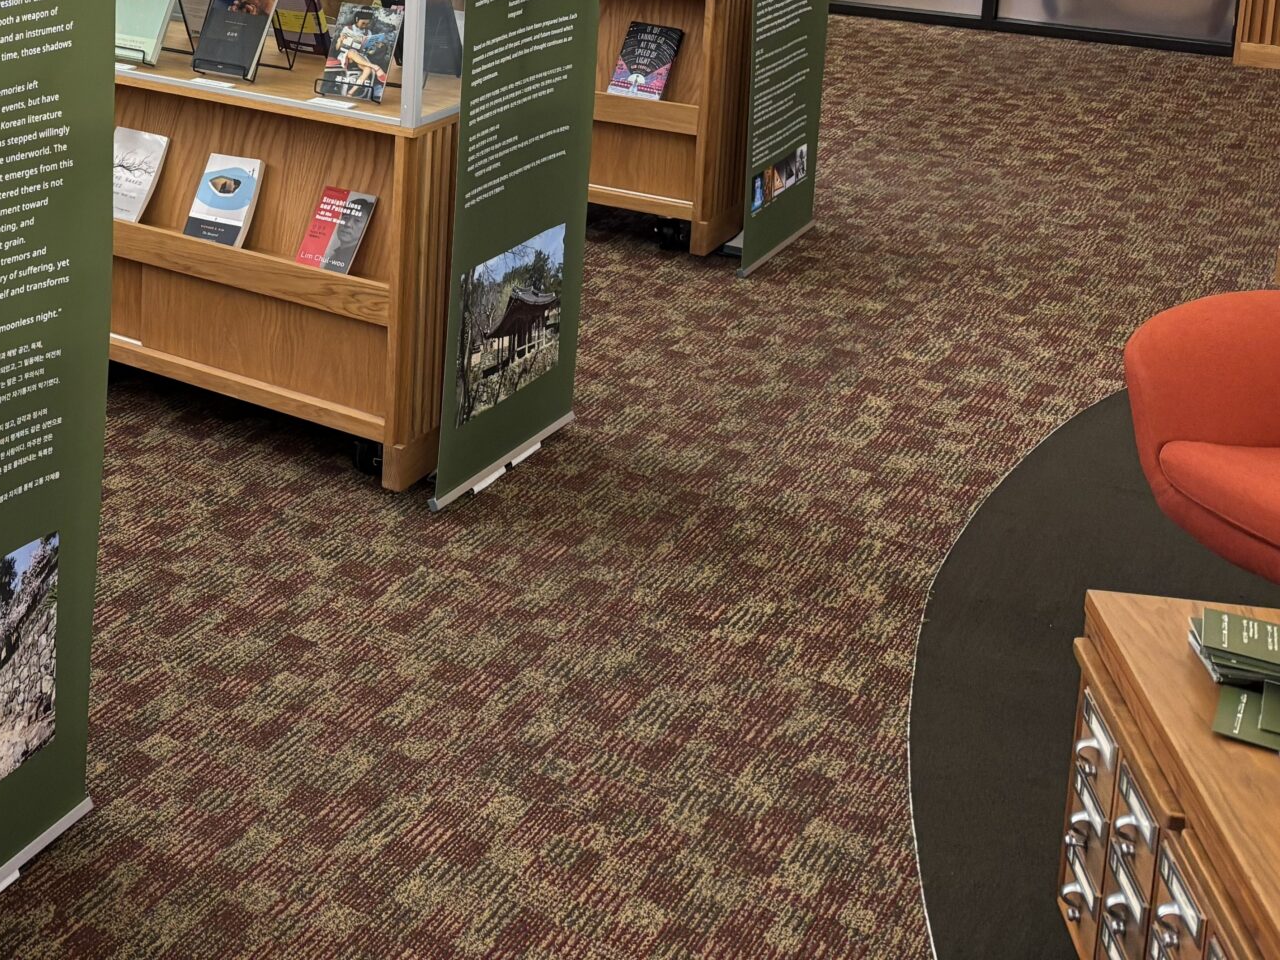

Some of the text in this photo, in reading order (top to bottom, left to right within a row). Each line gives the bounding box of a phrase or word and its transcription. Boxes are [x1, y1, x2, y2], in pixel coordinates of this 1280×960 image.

[638, 33, 656, 41] CANNOT
[648, 42, 657, 50] THE
[635, 49, 650, 57] SPEED
[636, 57, 650, 65] LIGHT
[323, 197, 361, 209] Straight Lines
[331, 206, 350, 215] Poison
[301, 251, 344, 267] Lim Chul-woo
[0, 316, 34, 333] moonless
[36, 308, 62, 322] night.”
